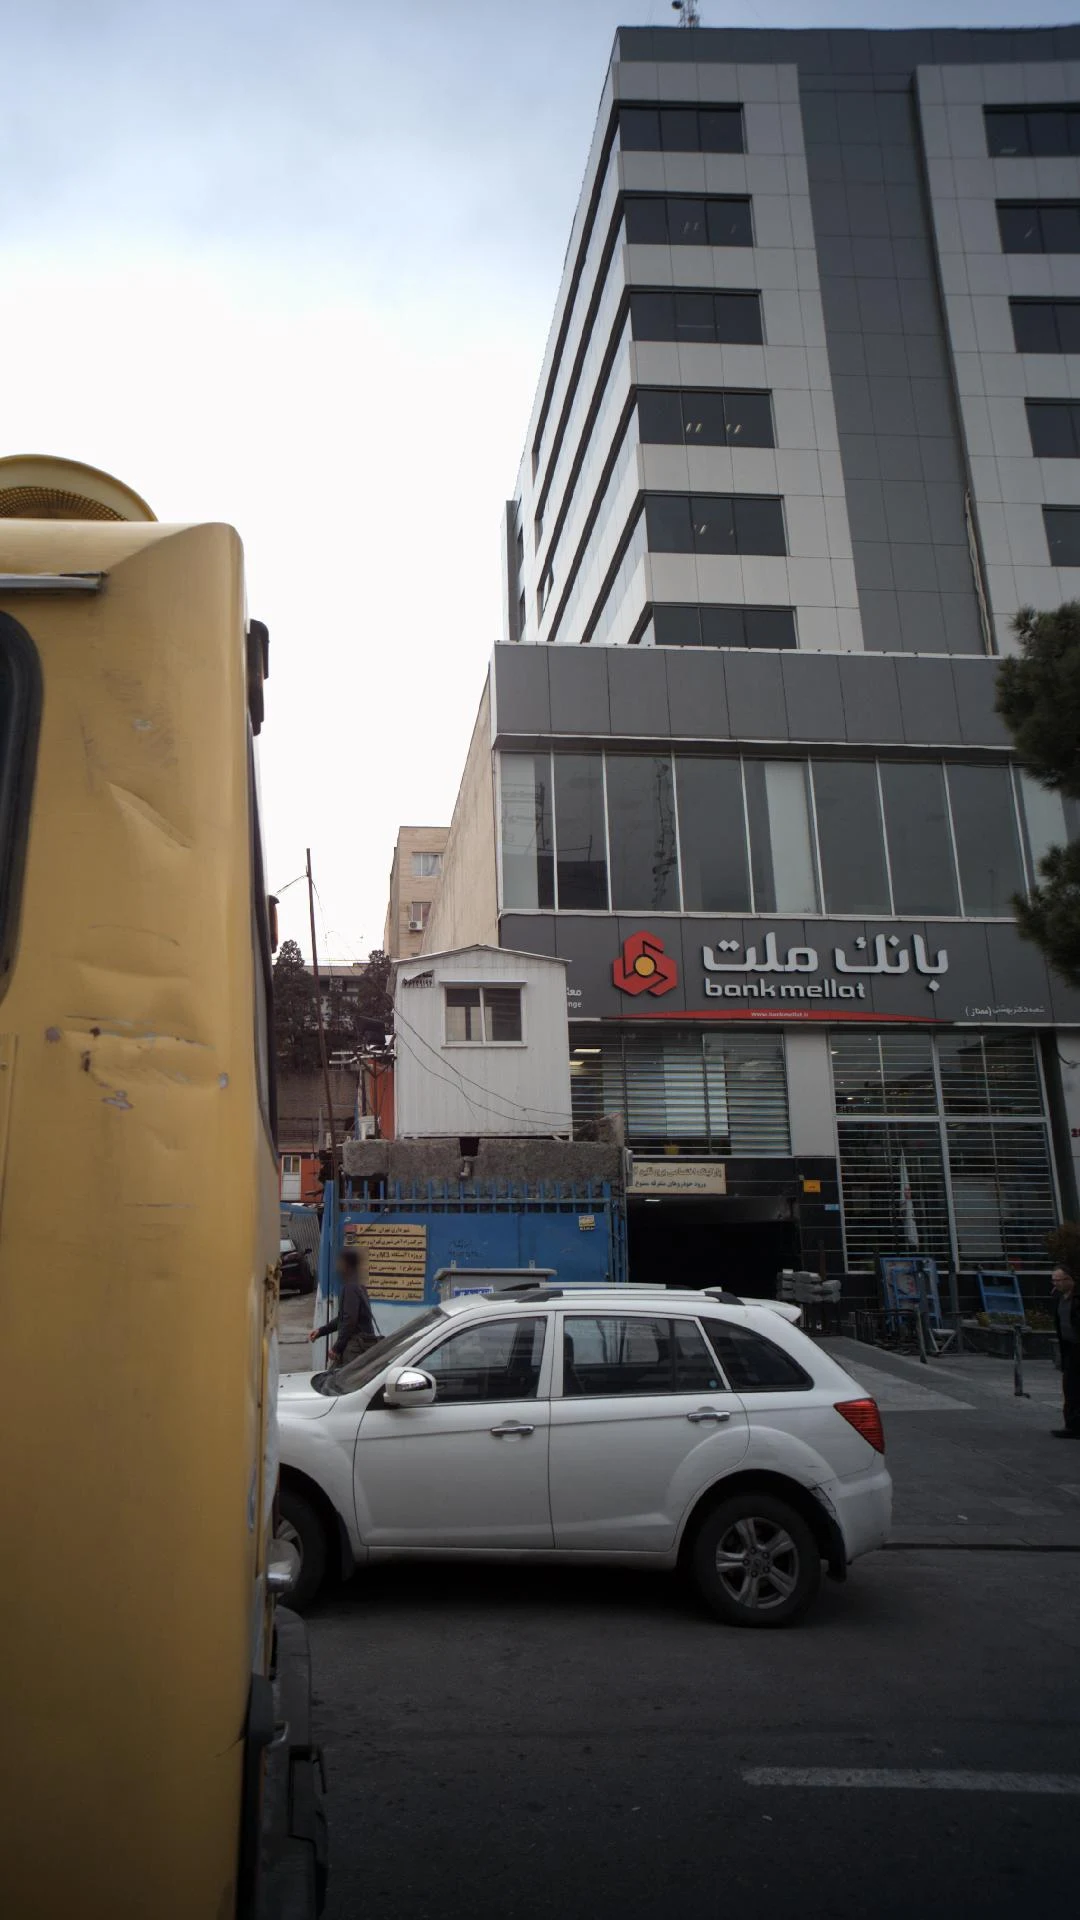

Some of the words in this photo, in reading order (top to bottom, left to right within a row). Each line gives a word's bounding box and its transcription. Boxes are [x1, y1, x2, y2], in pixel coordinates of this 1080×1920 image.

[702, 932, 819, 972] ملت
[705, 978, 776, 997] bank
[780, 978, 866, 998] mellat
[635, 1180, 650, 1188] ممنوع
[651, 1180, 666, 1188] متفرقه
[667, 1180, 693, 1188] خودروهای
